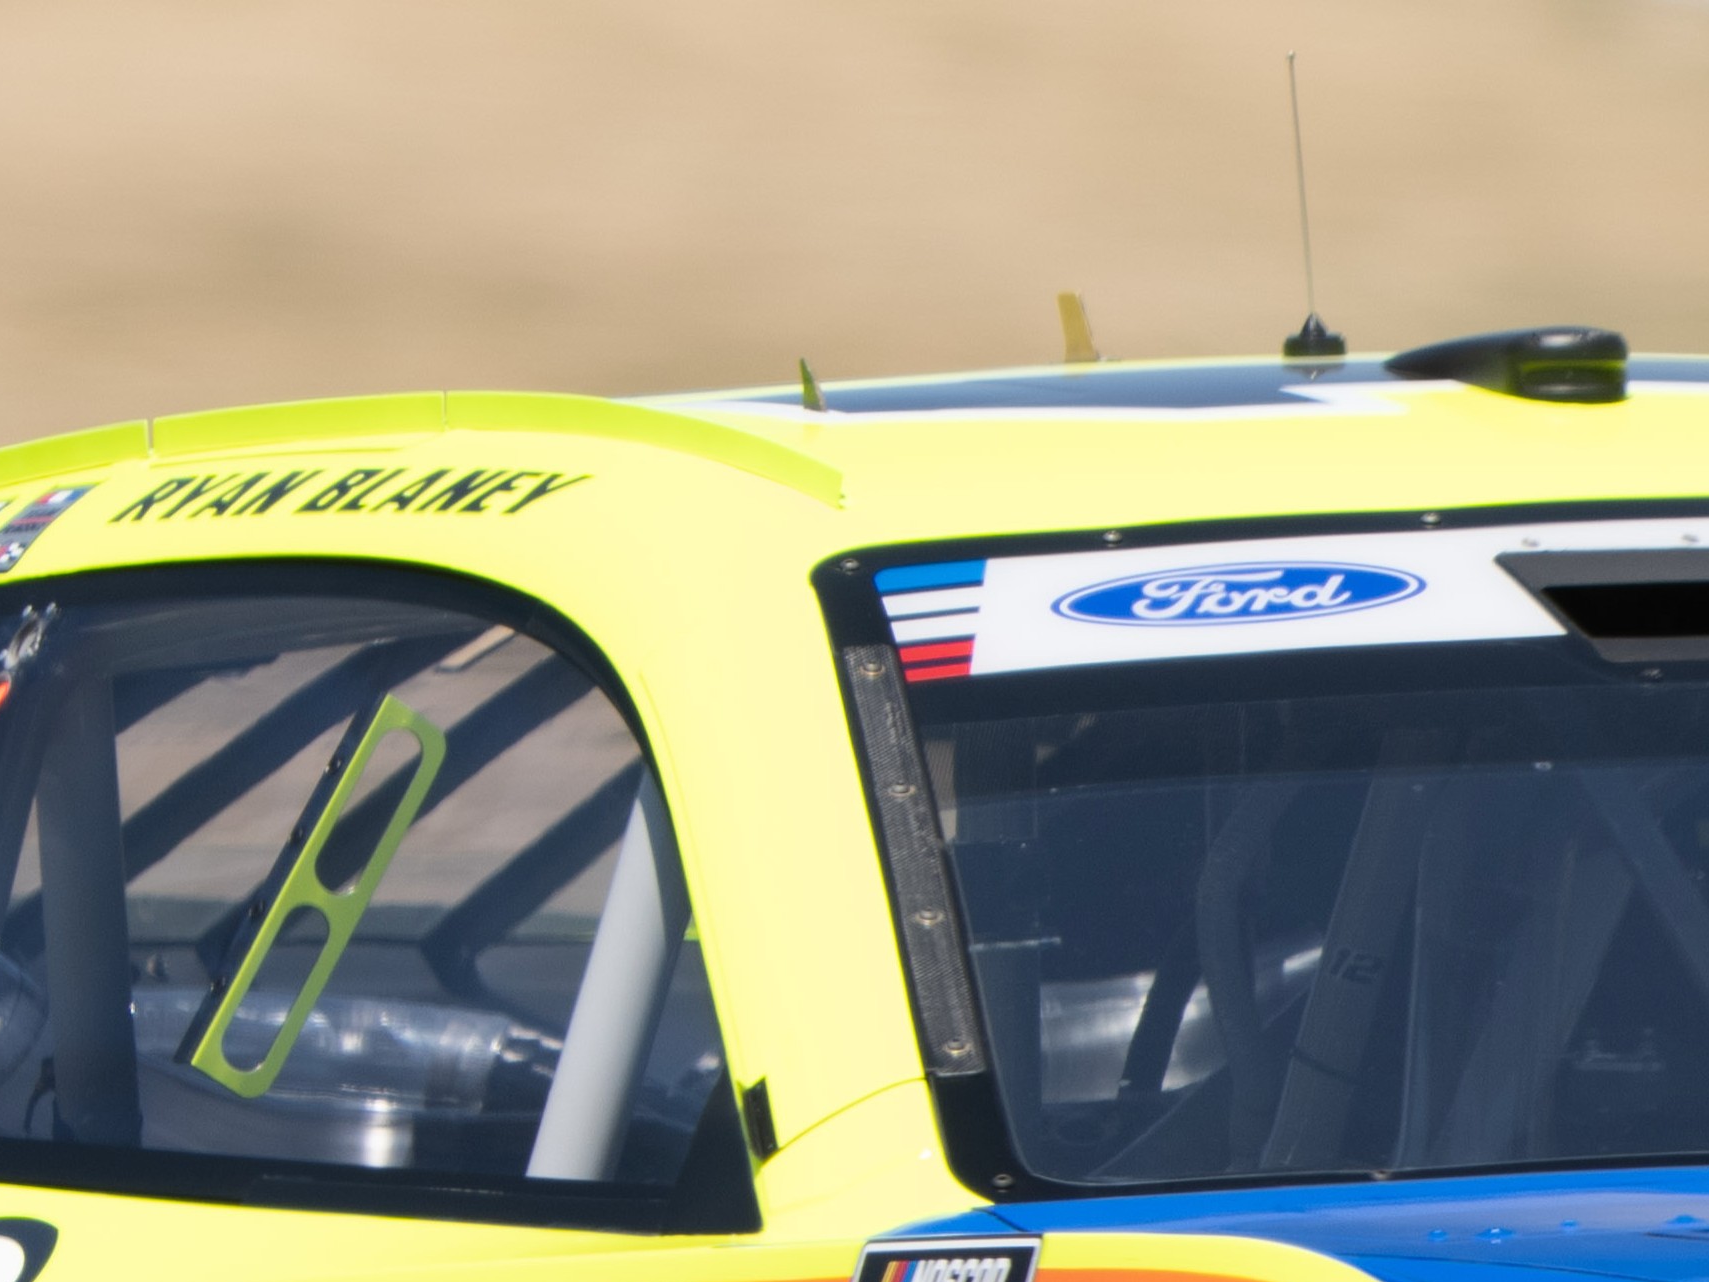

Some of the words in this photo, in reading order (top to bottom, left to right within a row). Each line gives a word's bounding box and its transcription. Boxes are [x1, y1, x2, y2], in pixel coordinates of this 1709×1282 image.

[108, 468, 326, 523] RYAN
[293, 467, 593, 515] BLANEY
[1131, 569, 1353, 620] Ford
